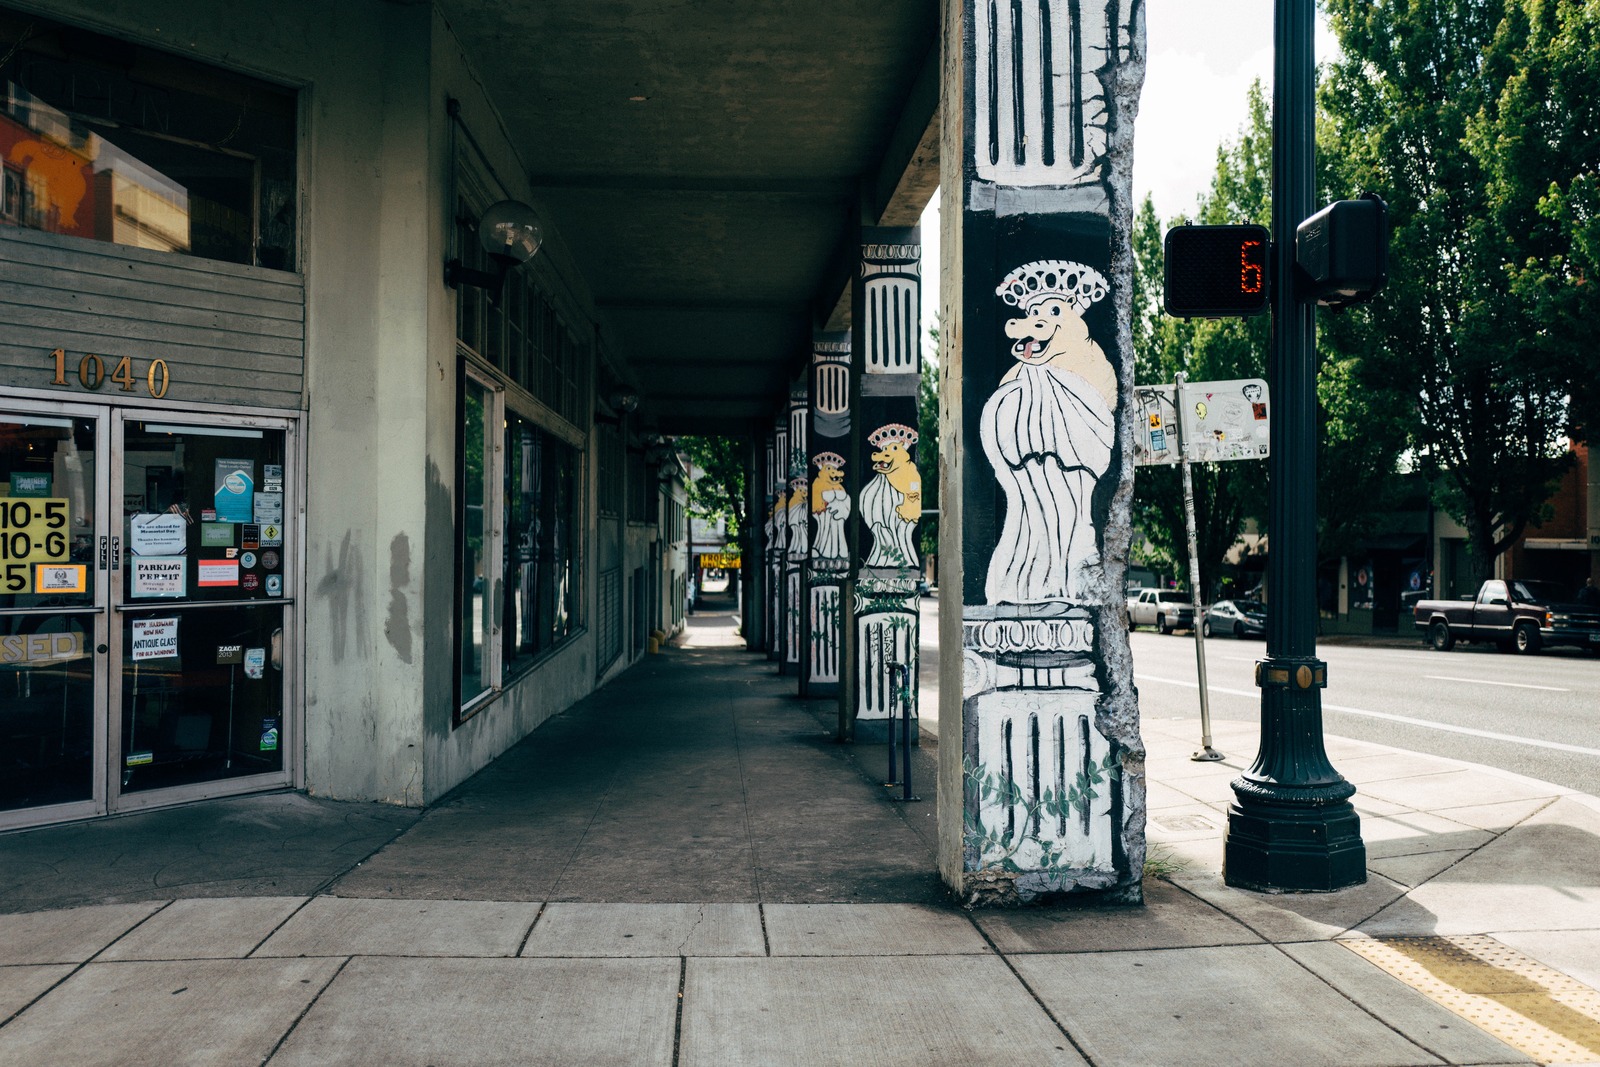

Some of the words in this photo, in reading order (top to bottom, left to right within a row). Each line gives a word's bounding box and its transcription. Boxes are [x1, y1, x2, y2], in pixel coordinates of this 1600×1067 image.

[1241, 240, 1262, 293] 6
[49, 348, 170, 399] 1040
[0, 502, 66, 529] 10-5
[0, 531, 66, 560] 10-6
[0, 564, 27, 591] 5
[2, 632, 77, 662] SED
[133, 638, 159, 649] ANTIQUE
[160, 637, 177, 647] GLASS
